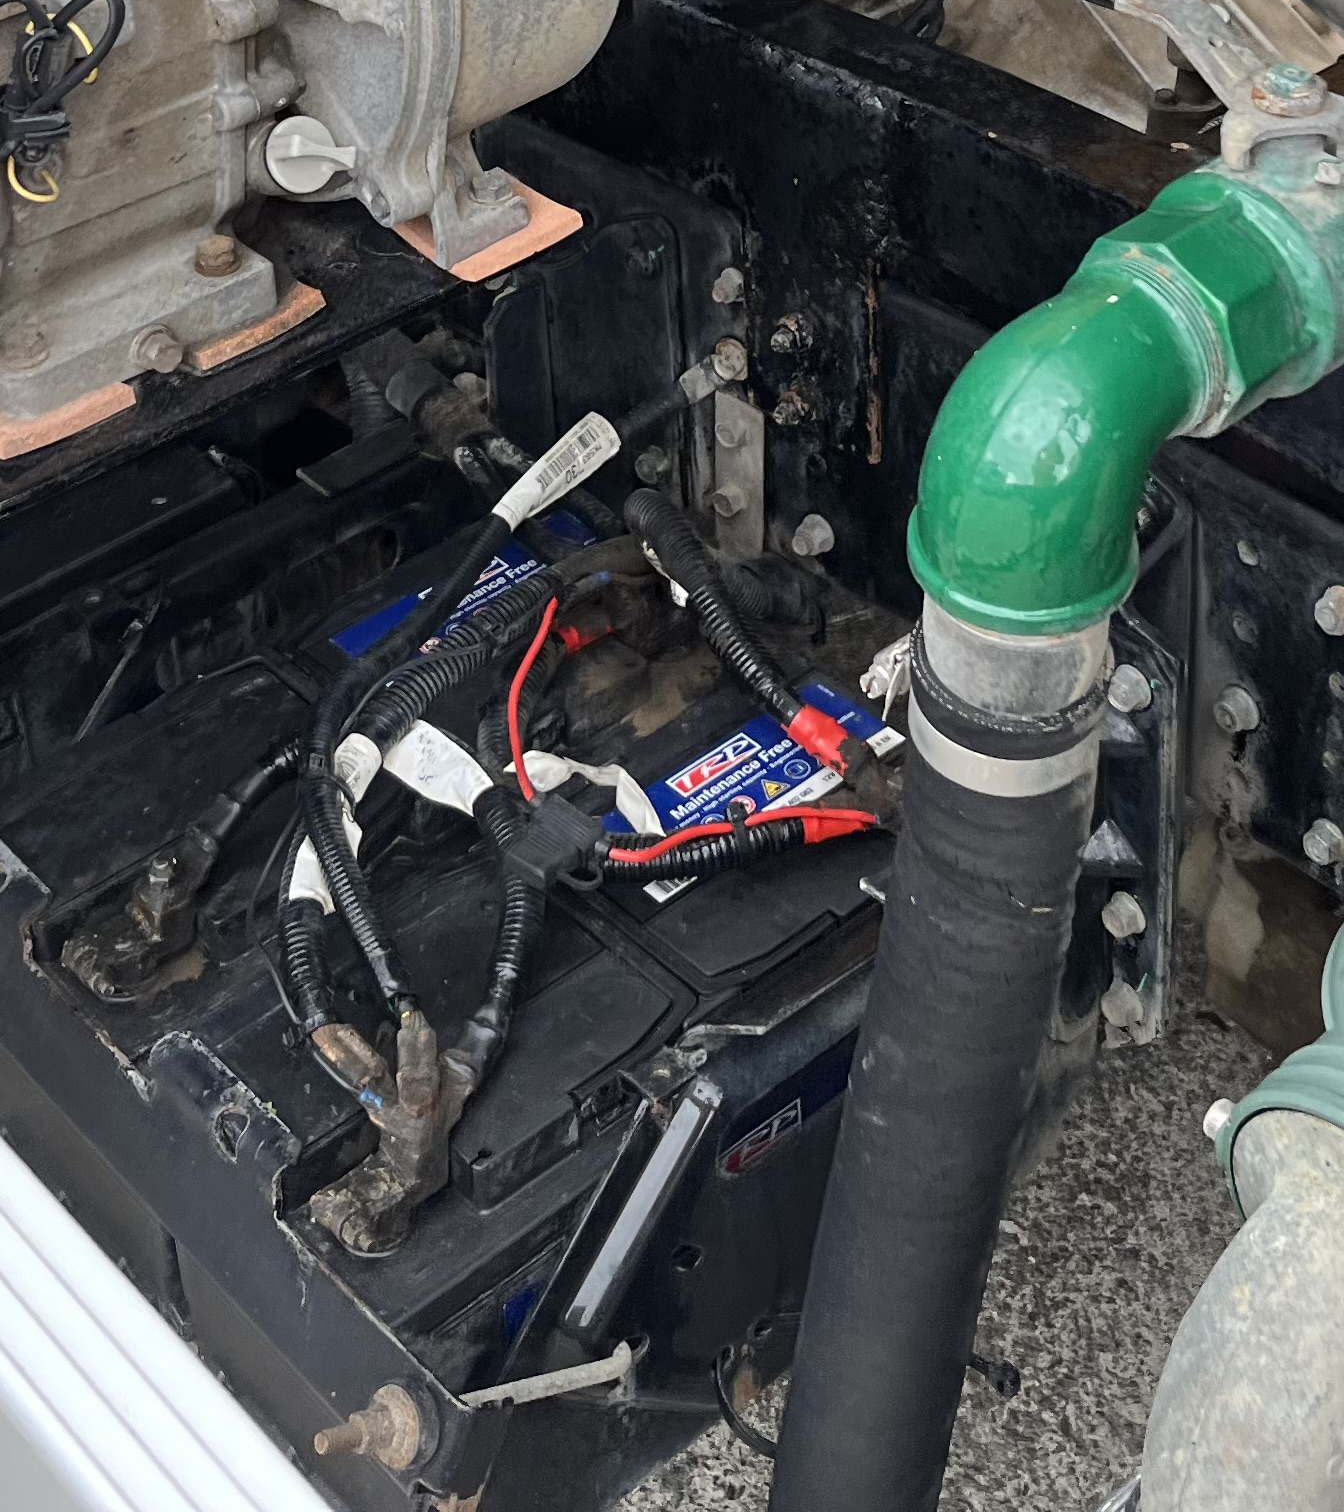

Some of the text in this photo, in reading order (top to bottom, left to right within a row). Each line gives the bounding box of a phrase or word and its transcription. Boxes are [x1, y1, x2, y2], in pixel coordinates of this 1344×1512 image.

[505, 555, 537, 580] Free
[670, 757, 761, 819] Maintenance
[757, 736, 793, 763] Free
[672, 735, 759, 798] TRP
